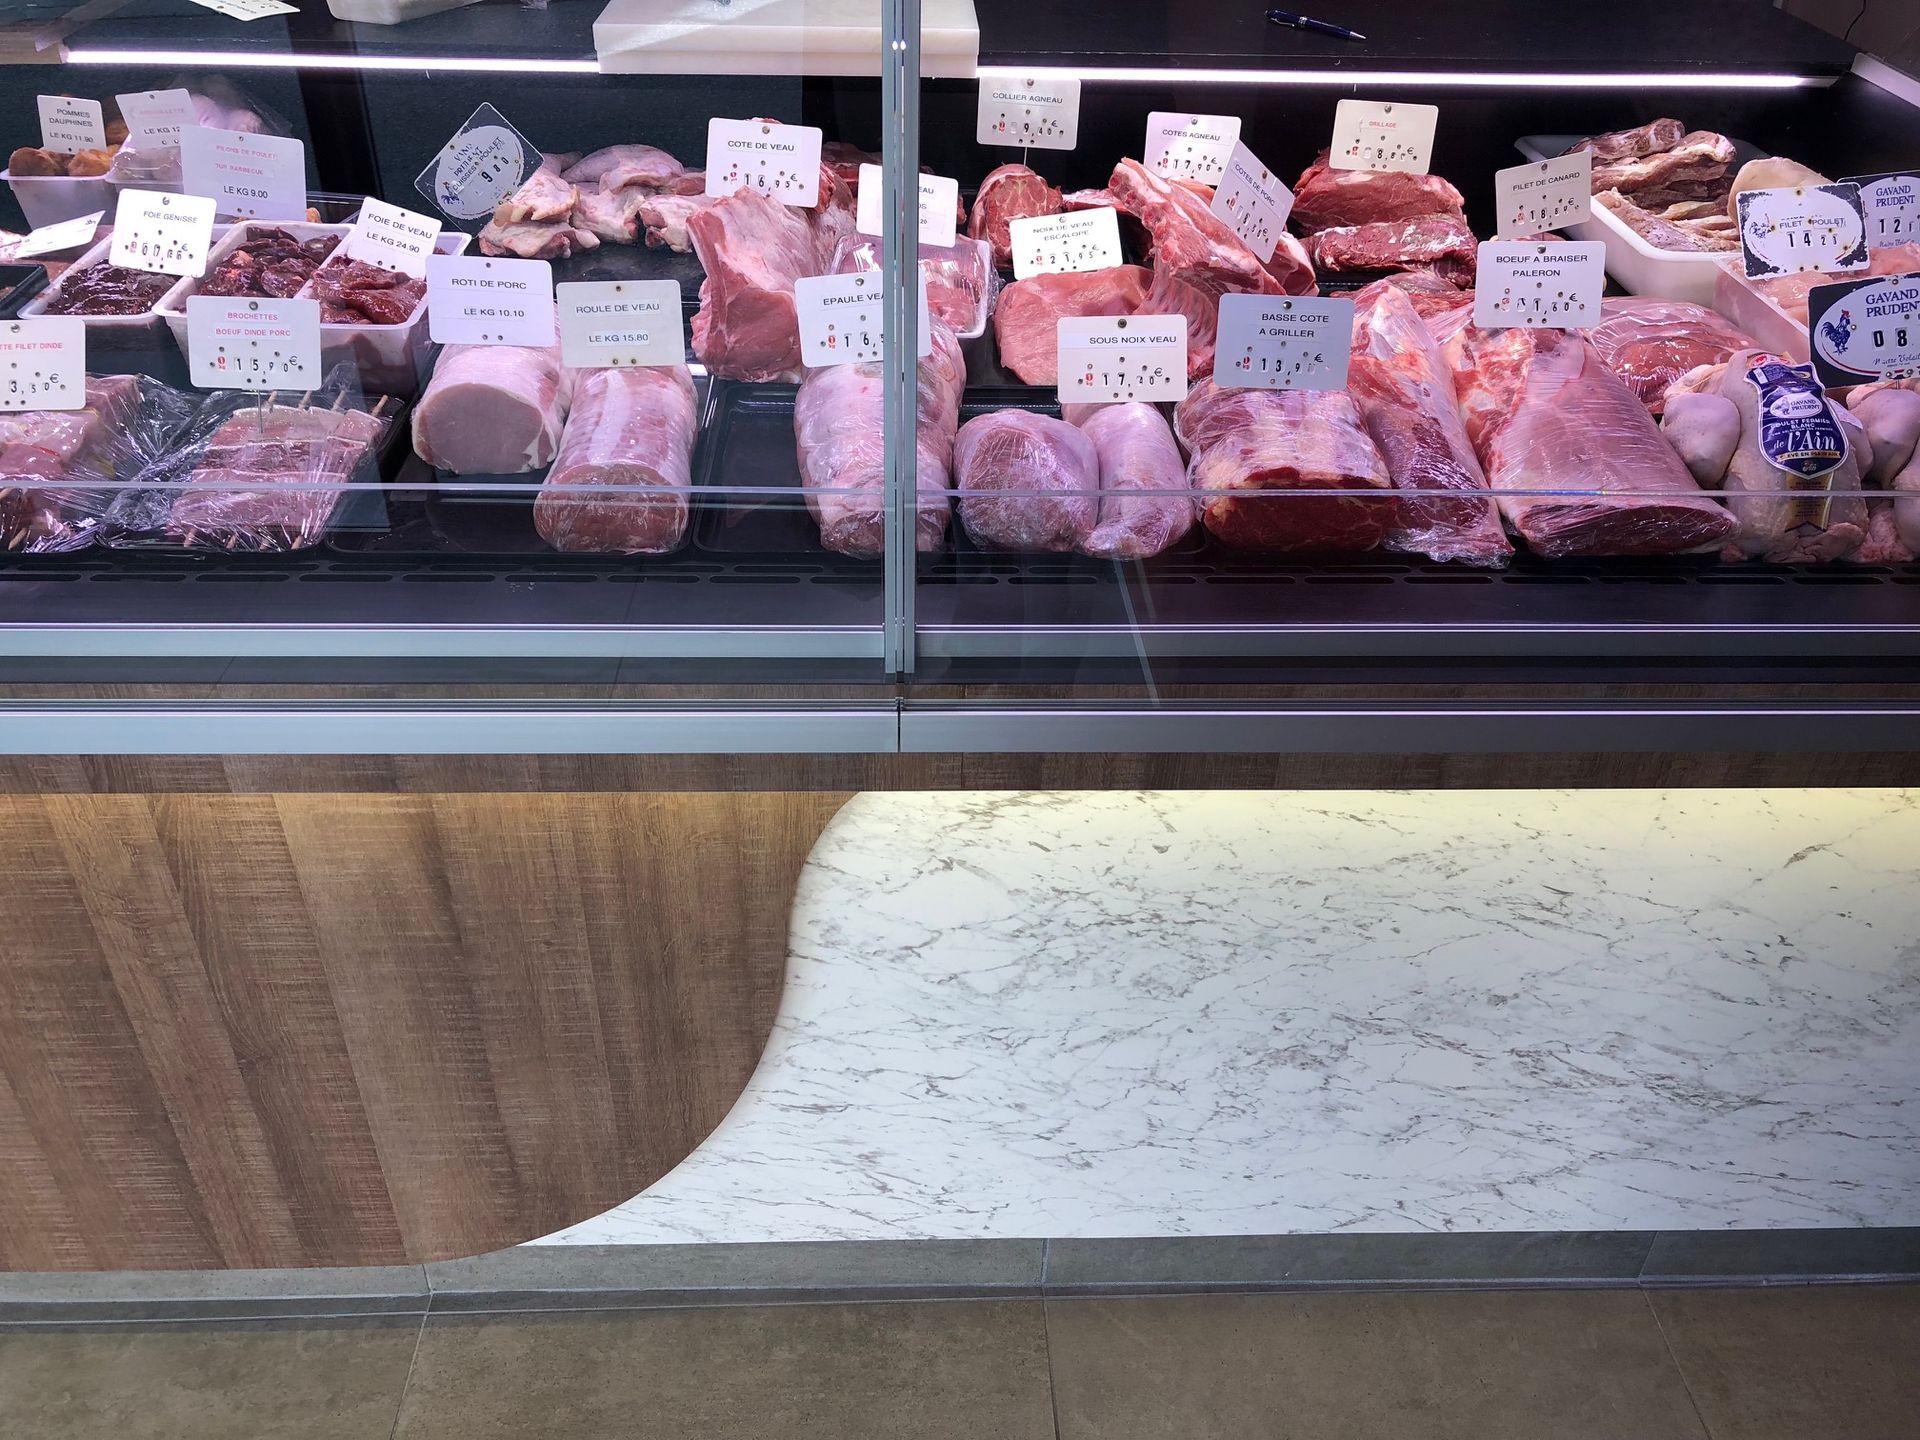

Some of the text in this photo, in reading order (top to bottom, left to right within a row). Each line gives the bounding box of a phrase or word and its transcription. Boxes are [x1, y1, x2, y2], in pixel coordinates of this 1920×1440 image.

[992, 92, 1063, 104] COLLIER AGNEAU
[57, 109, 90, 118] POMMES
[49, 118, 93, 127] DAUPHINES
[1162, 129, 1220, 141] COTES AGNEAU
[728, 140, 795, 151] COTE DE VEAU
[452, 136, 502, 191] CUISSES POULET
[1235, 164, 1275, 206] COTES DE PORC
[1512, 182, 1534, 191] FILET
[1548, 172, 1580, 184] CANARD
[224, 186, 268, 198] LE KG 9.00
[918, 186, 934, 194] EAU
[1876, 185, 1911, 196] GAVAND
[1876, 195, 1916, 207] PRUDENT
[143, 211, 198, 223] FOIE GENISSE
[368, 213, 432, 239] FOIE DE VEAU
[1070, 221, 1094, 229] VEAU
[1780, 220, 1802, 229] FILET
[1044, 230, 1089, 241] ESCALOPE
[366, 233, 420, 253] LE KG 24.90
[1496, 254, 1588, 263] BOEUF A BRAISER
[1512, 269, 1561, 277] PALERON
[451, 278, 527, 290] ROTI DE PORC
[823, 295, 864, 306] EPAULE
[1865, 288, 1919, 304] GAVAND
[464, 308, 525, 318] LE KG 10.10
[576, 303, 660, 313] ROULE DE VEAU
[227, 312, 278, 321] BROCHETTES
[1261, 313, 1329, 323] BASSE COTE
[215, 328, 290, 337] BOEUF DINDE PORC
[1259, 328, 1315, 338] A GRILLER
[589, 333, 649, 343] LE KG 15.80
[1089, 335, 1177, 344] SOUS NOIX VEAU
[1774, 440, 1785, 448] de
